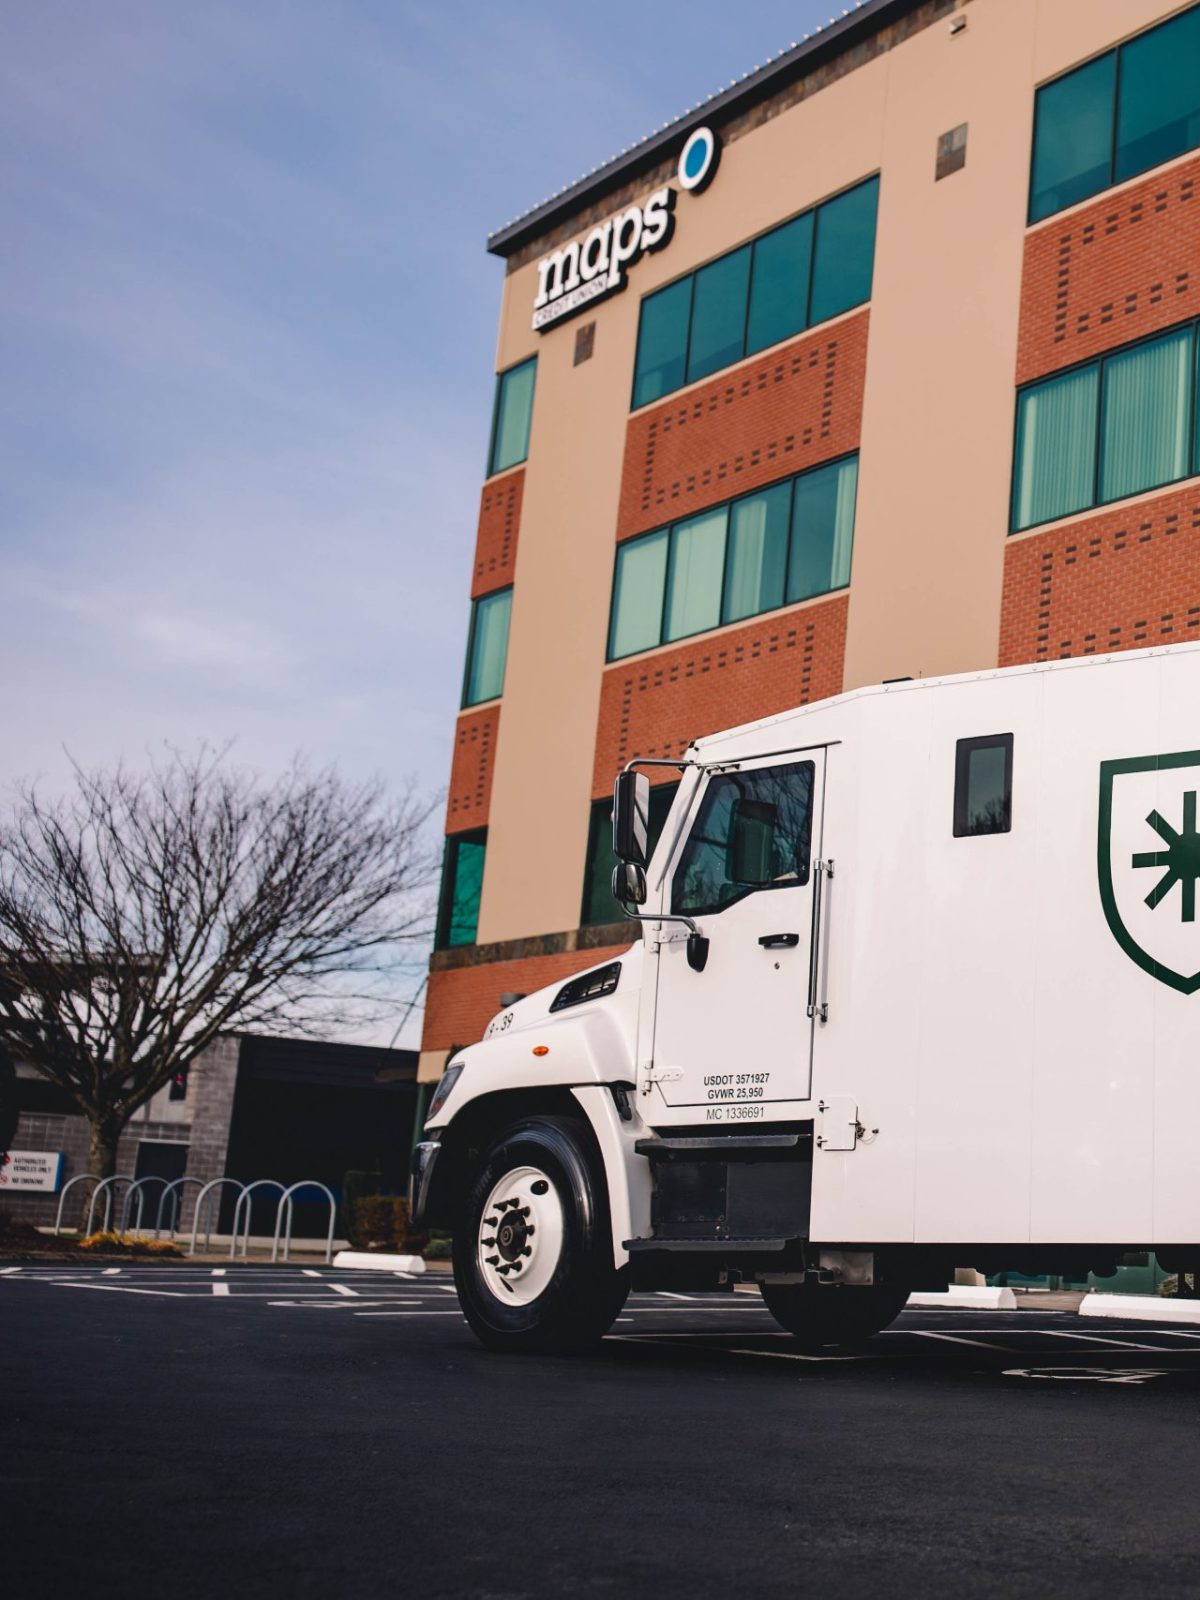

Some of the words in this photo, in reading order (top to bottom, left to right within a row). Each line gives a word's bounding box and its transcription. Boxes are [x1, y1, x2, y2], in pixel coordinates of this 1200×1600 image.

[533, 187, 670, 309] maps
[703, 1074, 734, 1087] USDOT
[735, 1072, 770, 1085] 3571927
[707, 1088, 735, 1100] GVWR
[736, 1086, 764, 1099] 25,950
[706, 1108, 723, 1120] MC
[726, 1105, 765, 1119] 1336691
